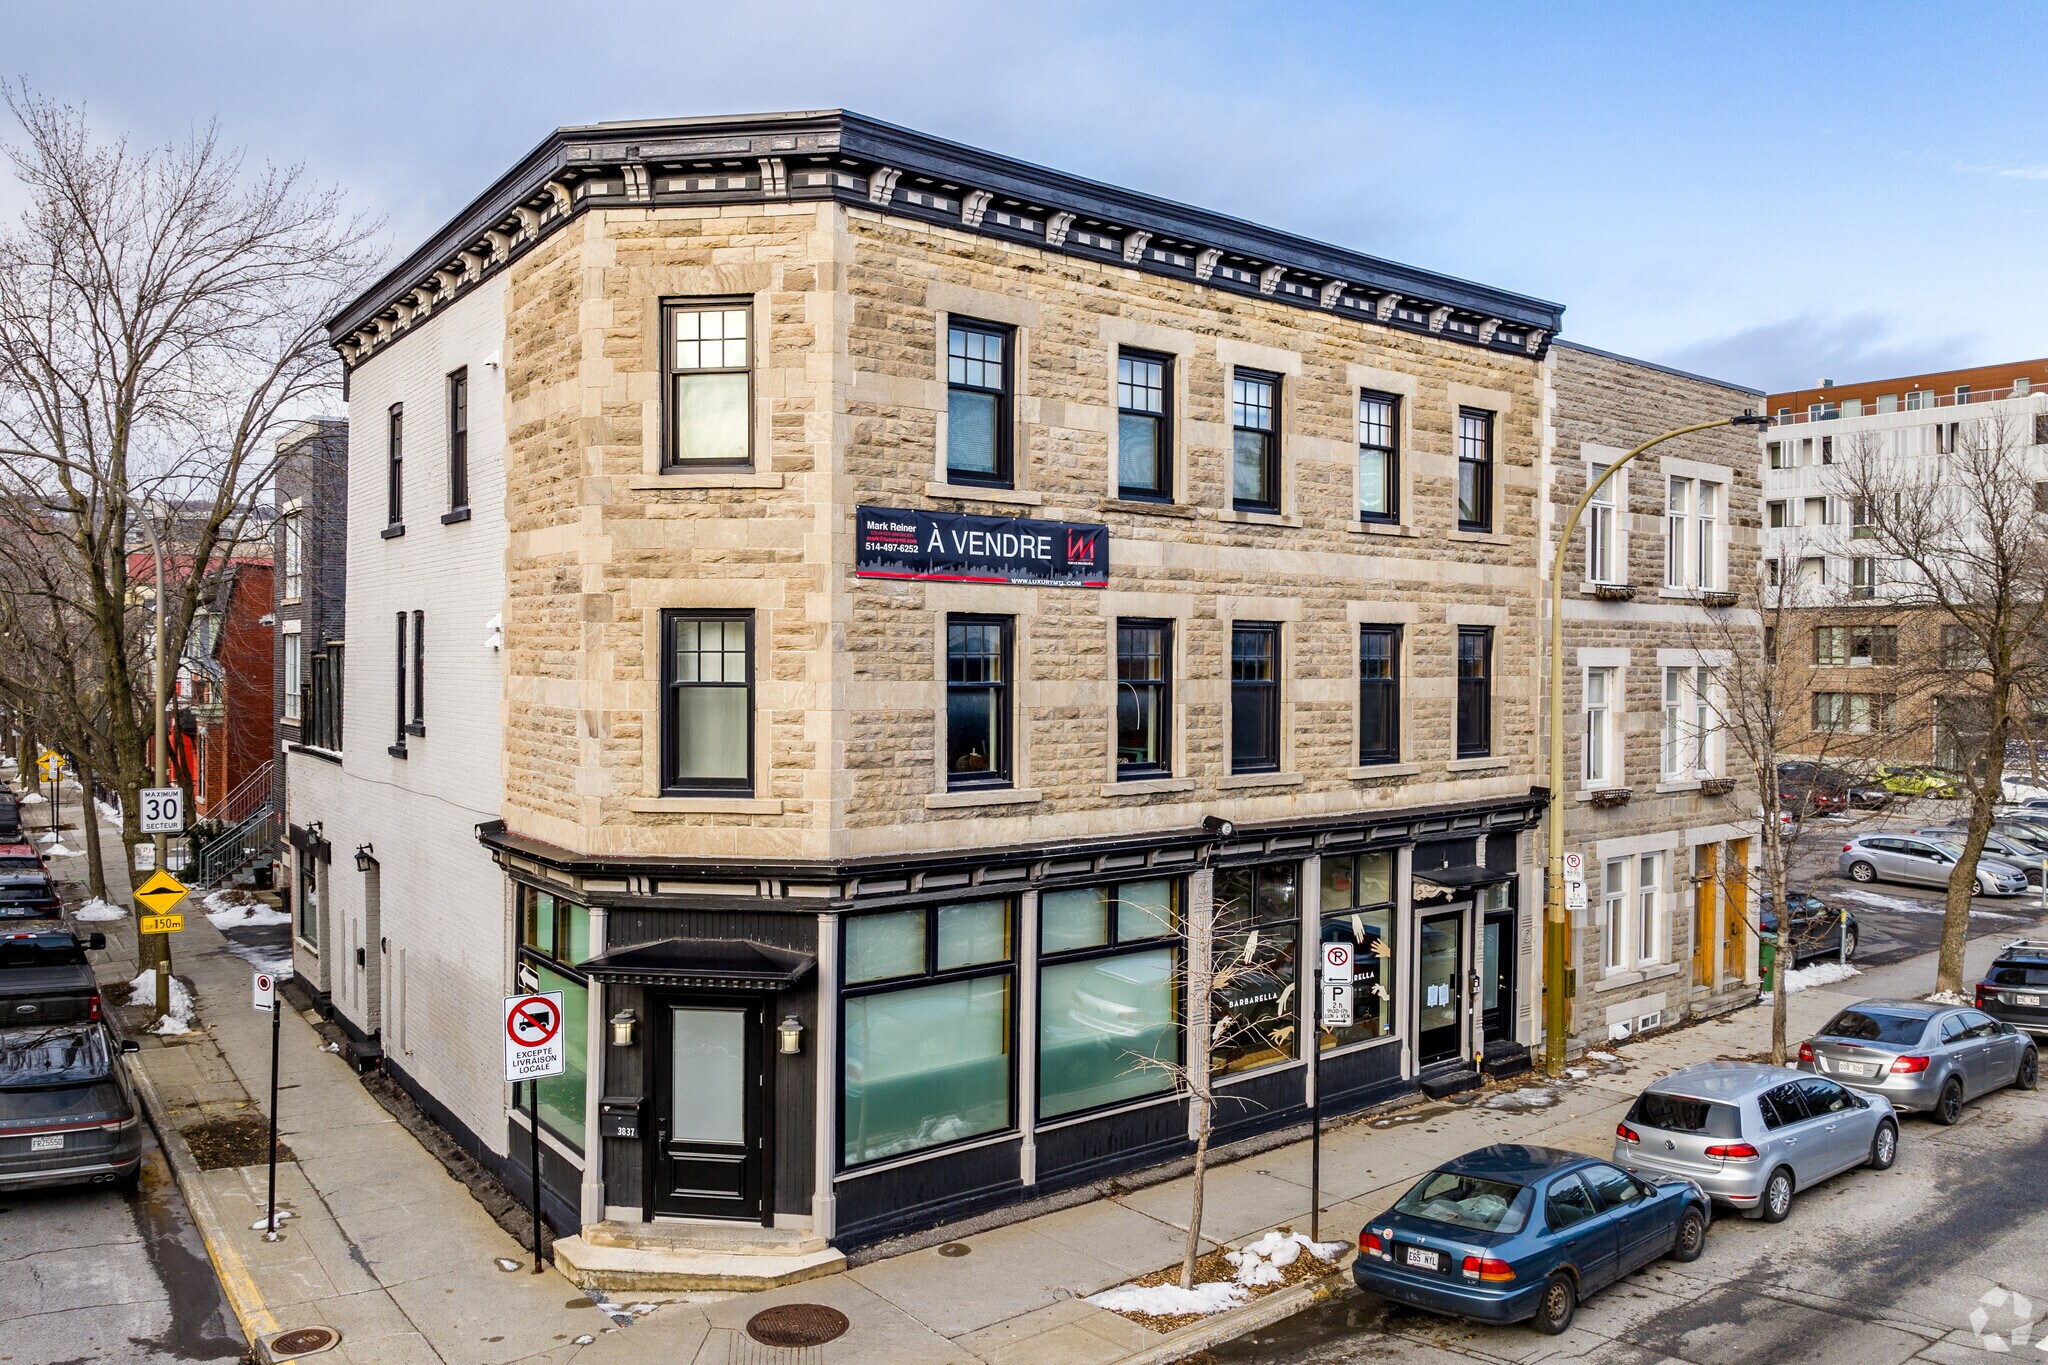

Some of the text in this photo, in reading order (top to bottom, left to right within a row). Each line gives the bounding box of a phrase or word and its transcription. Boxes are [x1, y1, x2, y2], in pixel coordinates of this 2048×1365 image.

[867, 520, 917, 532] Mark Reiner
[927, 522, 1052, 560] À VENDRE
[866, 542, 919, 554] 514-497-6252
[146, 799, 177, 820] 30
[1573, 882, 1580, 892] P
[154, 919, 180, 929] 150m
[1229, 992, 1278, 1008] BARBARELLA
[1333, 987, 1343, 1001] P
[517, 1047, 552, 1059] EXCEPTÉ
[513, 1054, 557, 1067] LIVRAISON
[520, 1063, 550, 1073] LOCALE
[618, 1127, 635, 1136] 3837
[1409, 1252, 1436, 1265] E65 NYL
